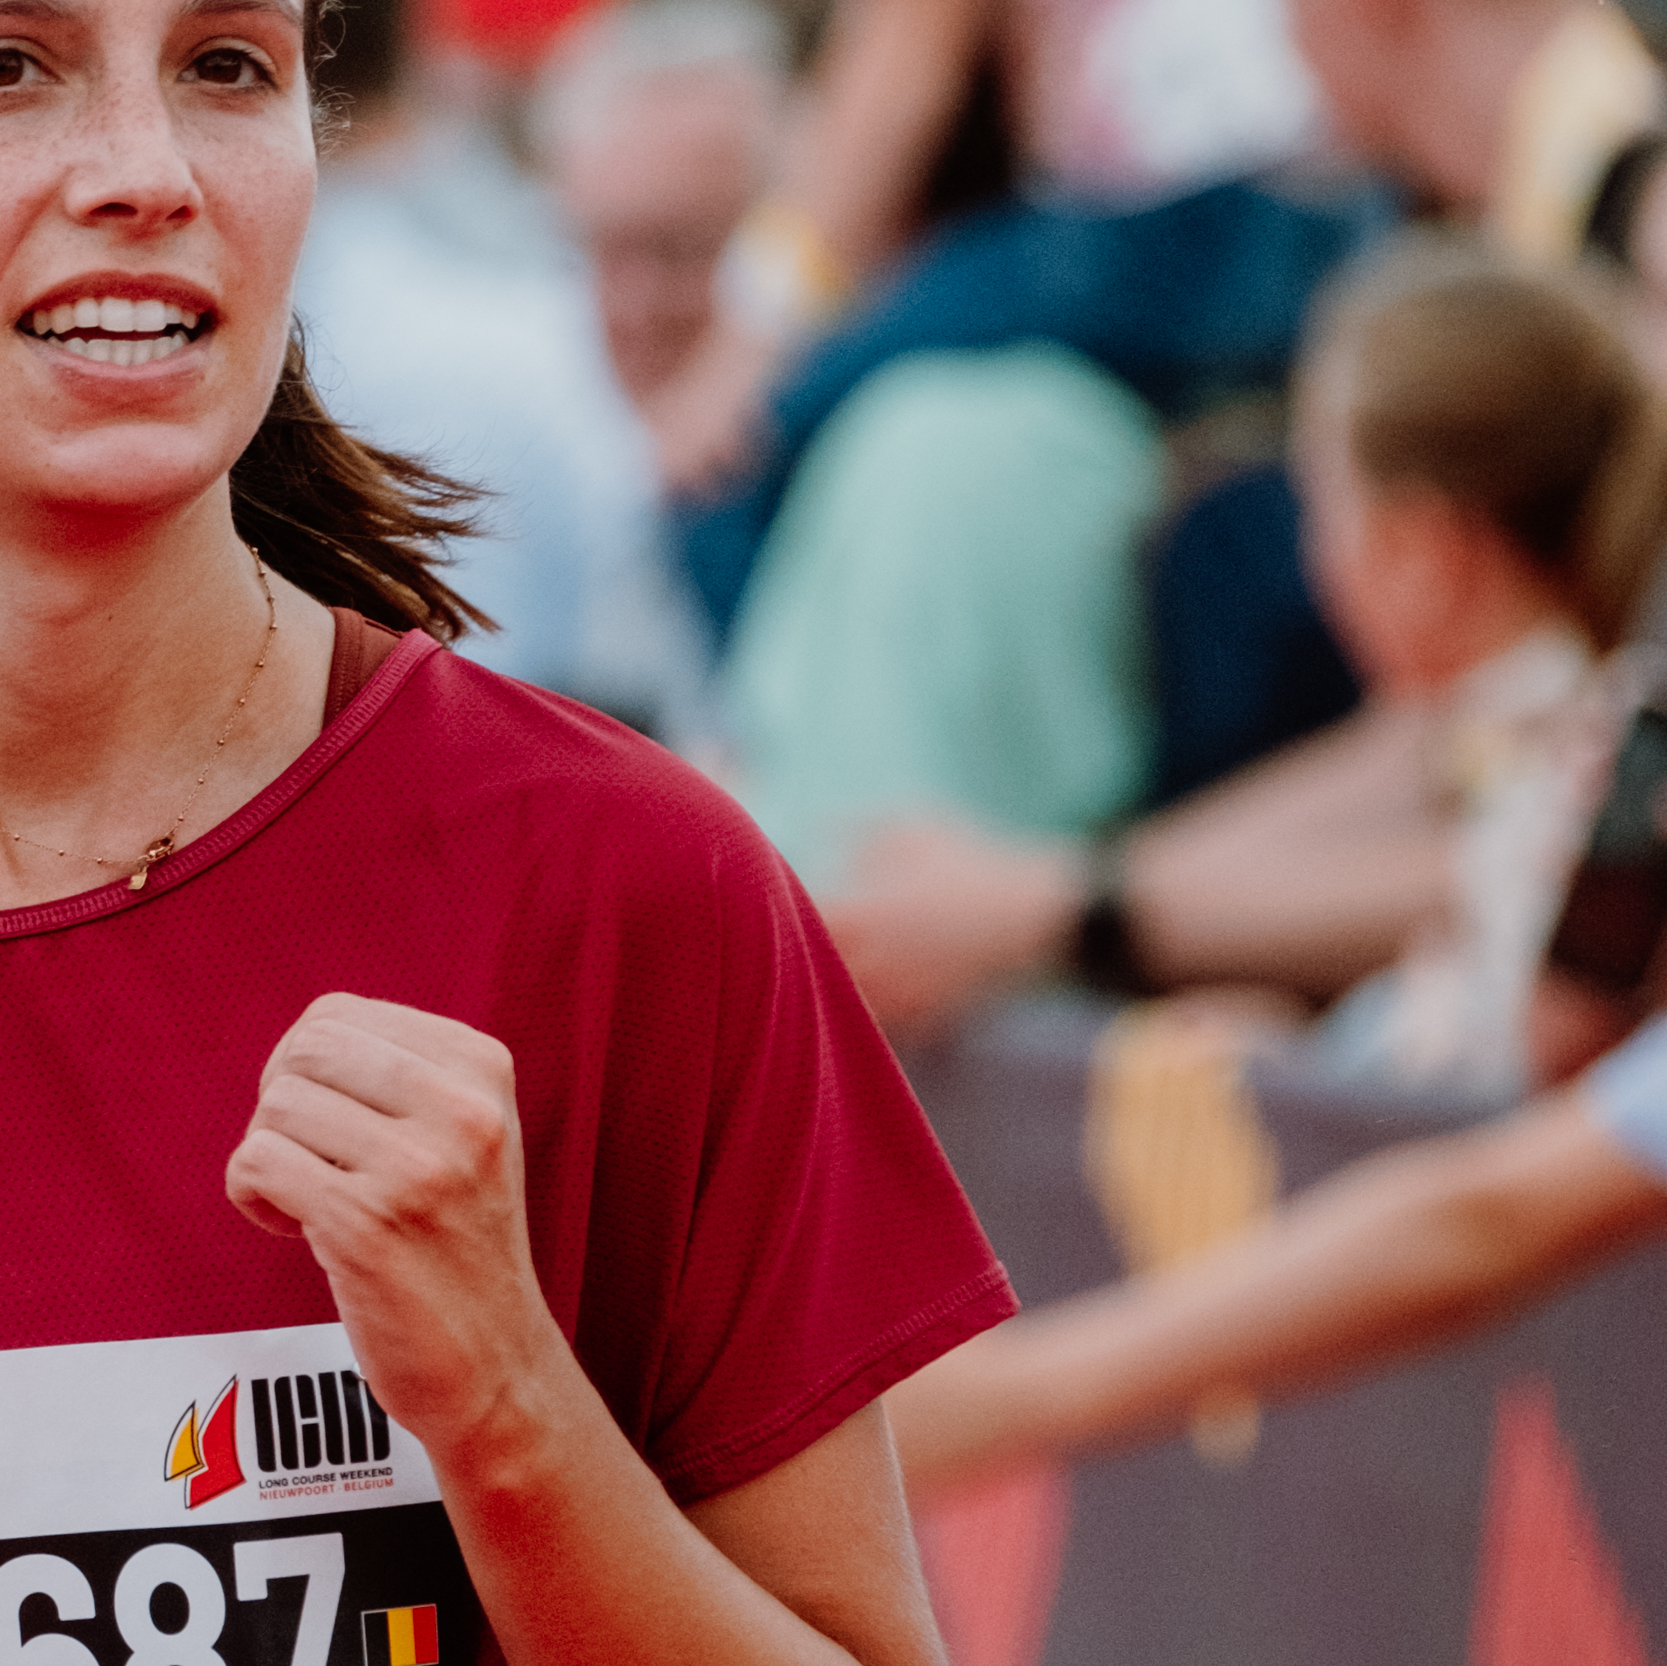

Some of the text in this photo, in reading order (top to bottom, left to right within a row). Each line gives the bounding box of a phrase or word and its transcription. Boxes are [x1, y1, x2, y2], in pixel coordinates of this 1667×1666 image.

[259, 1467, 393, 1490] LONG COURSE WEEKEND
[259, 1478, 394, 1501] NIEUWPOORT BELGIUM
